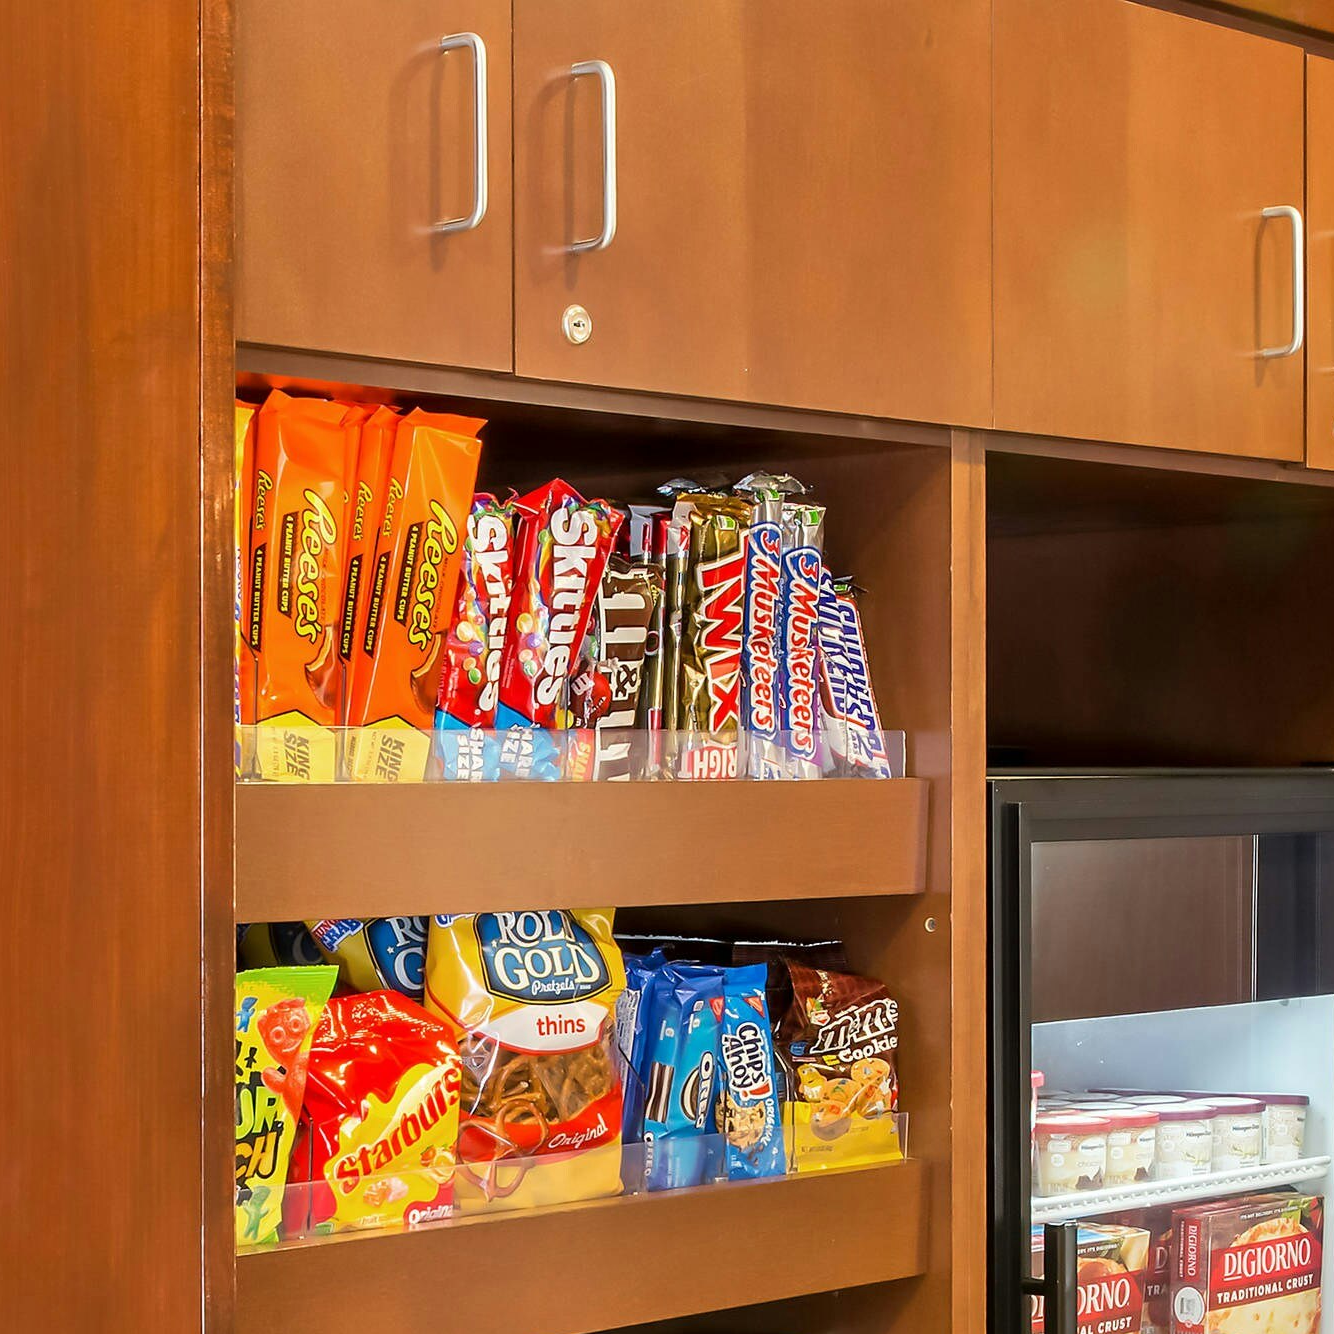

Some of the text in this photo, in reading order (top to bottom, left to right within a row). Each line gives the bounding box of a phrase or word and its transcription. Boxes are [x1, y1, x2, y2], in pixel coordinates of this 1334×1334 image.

[256, 470, 273, 530] Reese's
[353, 481, 373, 541] Reese's
[383, 477, 404, 537] Reese's
[285, 521, 294, 556] PEANUT
[408, 531, 418, 565] PEANUT
[761, 531, 780, 556] 3
[283, 557, 292, 588] BUTTER
[295, 489, 337, 643] Reese's
[402, 566, 412, 597] BUTTER
[409, 499, 458, 650] Reese's
[281, 591, 289, 612] CUPS
[397, 600, 407, 621] CUPS
[468, 516, 513, 711] Skittles
[537, 508, 599, 706] Skittles
[698, 530, 749, 735] TWIX
[753, 558, 781, 731] Musketeers
[788, 555, 819, 753] 3 Musketeers
[284, 731, 298, 776] SIZE
[297, 736, 310, 780] KING
[375, 735, 391, 778] SIZE
[387, 739, 405, 782] KING
[457, 734, 468, 780] SIZE
[469, 728, 484, 782] SHAR
[494, 943, 601, 991] GOLD
[532, 977, 575, 995] Pretzels
[537, 1014, 586, 1036] thins
[738, 1023, 766, 1085] Chips
[696, 1051, 714, 1129] OREO
[335, 1067, 461, 1194] Starburs
[549, 1113, 609, 1149] Original
[408, 1204, 453, 1225] Origina
[1187, 1224, 1198, 1277] DIGIORNO
[1223, 1238, 1312, 1279] DIGIORNO
[1217, 1273, 1314, 1305] TRADITIONAL CRUST
[1097, 1316, 1133, 1334] CRUST
